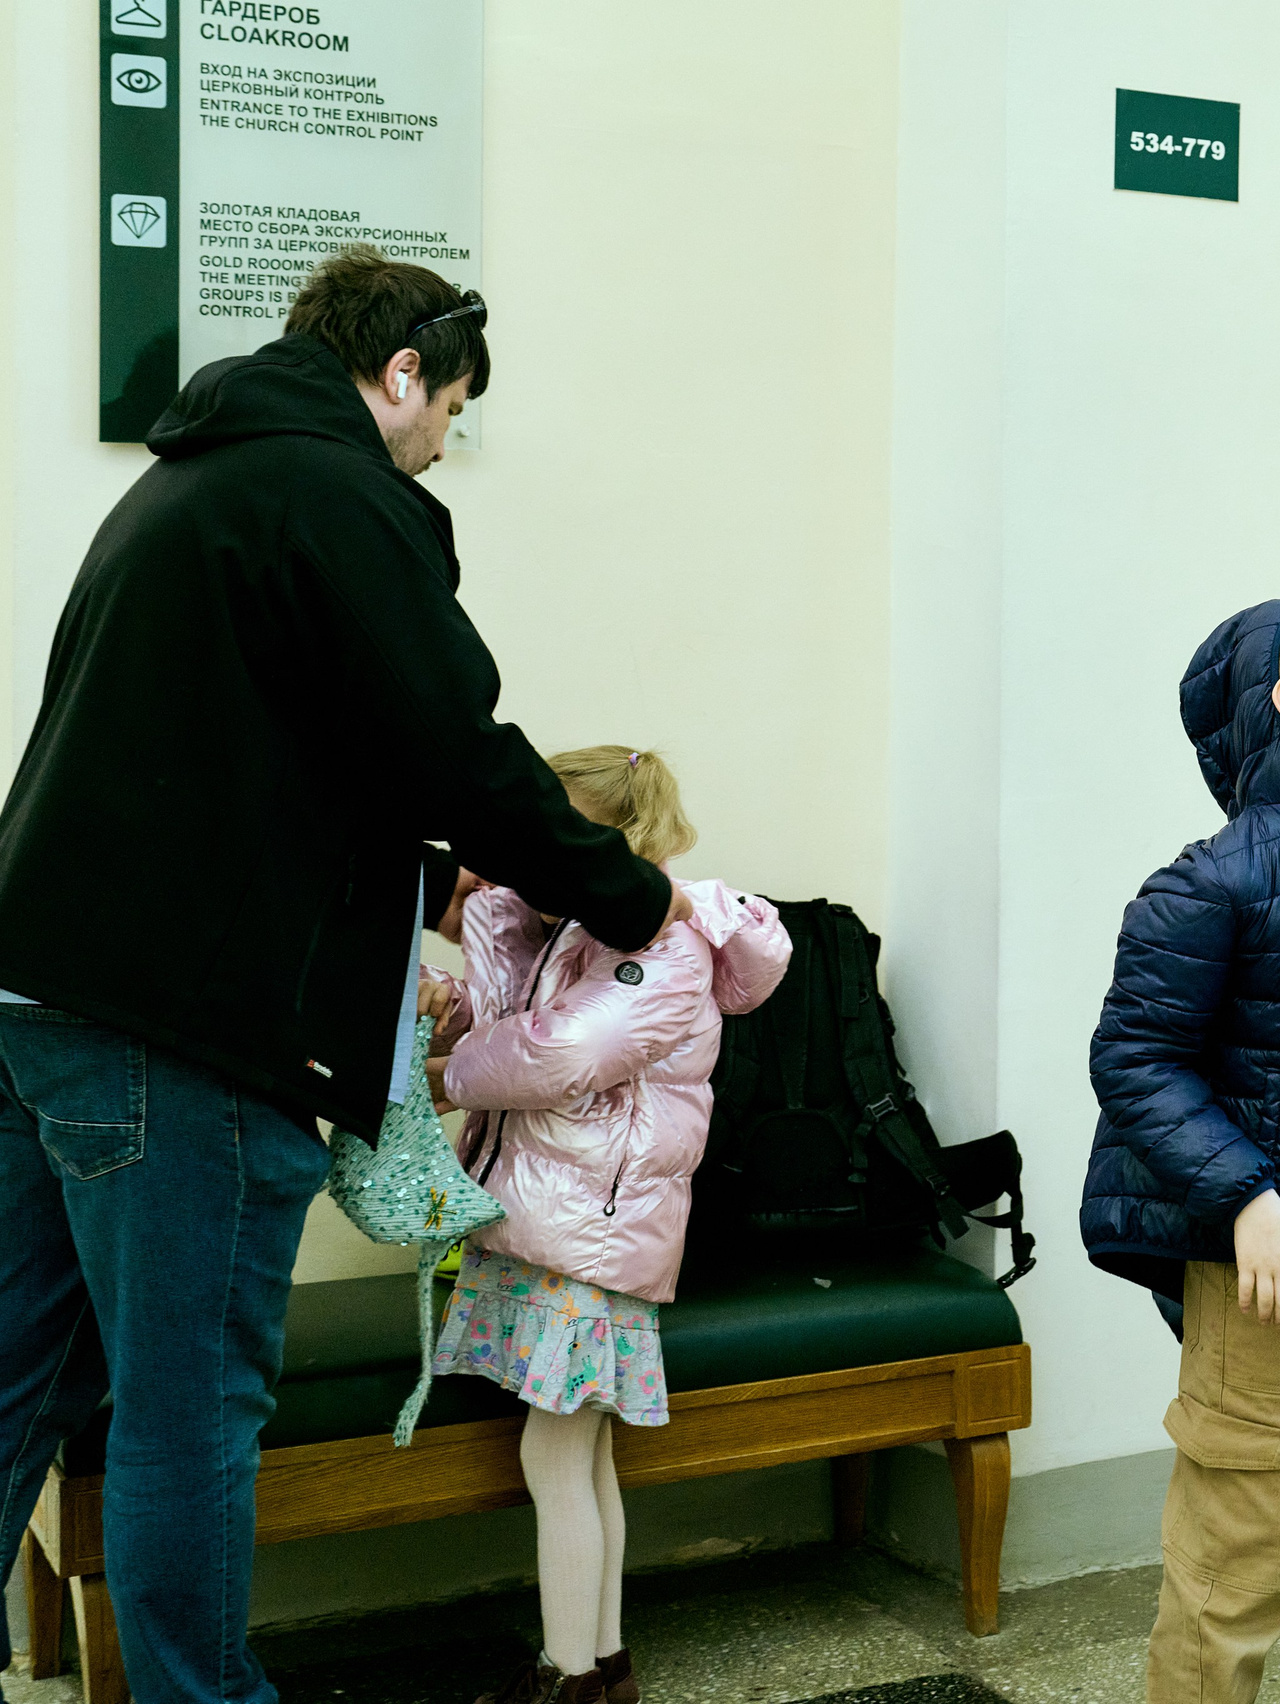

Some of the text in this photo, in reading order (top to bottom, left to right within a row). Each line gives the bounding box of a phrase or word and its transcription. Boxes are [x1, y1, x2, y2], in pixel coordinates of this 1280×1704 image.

[200, 0, 320, 25] ГАРДЕРОБ
[200, 23, 349, 52] CLOAKROOM
[200, 63, 377, 89] ВХОД НА ЭКСПОЗИЦИИ
[200, 79, 385, 105] ЦЕРКОВНЫЙ КОНТРОЛЬ
[200, 98, 438, 127] ENTRANCE TO THE EXHIBITIONS
[200, 114, 424, 142] THE CHURCH CONTROL POINT
[1130, 131, 1226, 160] 534-779
[200, 202, 360, 223] ЗОЛОТАЯ КЛАДОВАЯ
[200, 219, 448, 243] МЕСТО СБОРА ЭКСКУРСИОННЫХ
[200, 236, 249, 250] ГРУПП
[253, 238, 274, 250] ЗА
[382, 244, 470, 260] КОНТРОЛЕМ
[200, 255, 315, 272] GOLD ROOOMS
[200, 271, 301, 288] THE MEETING
[200, 288, 264, 303] GROUPS
[269, 291, 282, 303] IS
[200, 304, 273, 319] CONTROL
